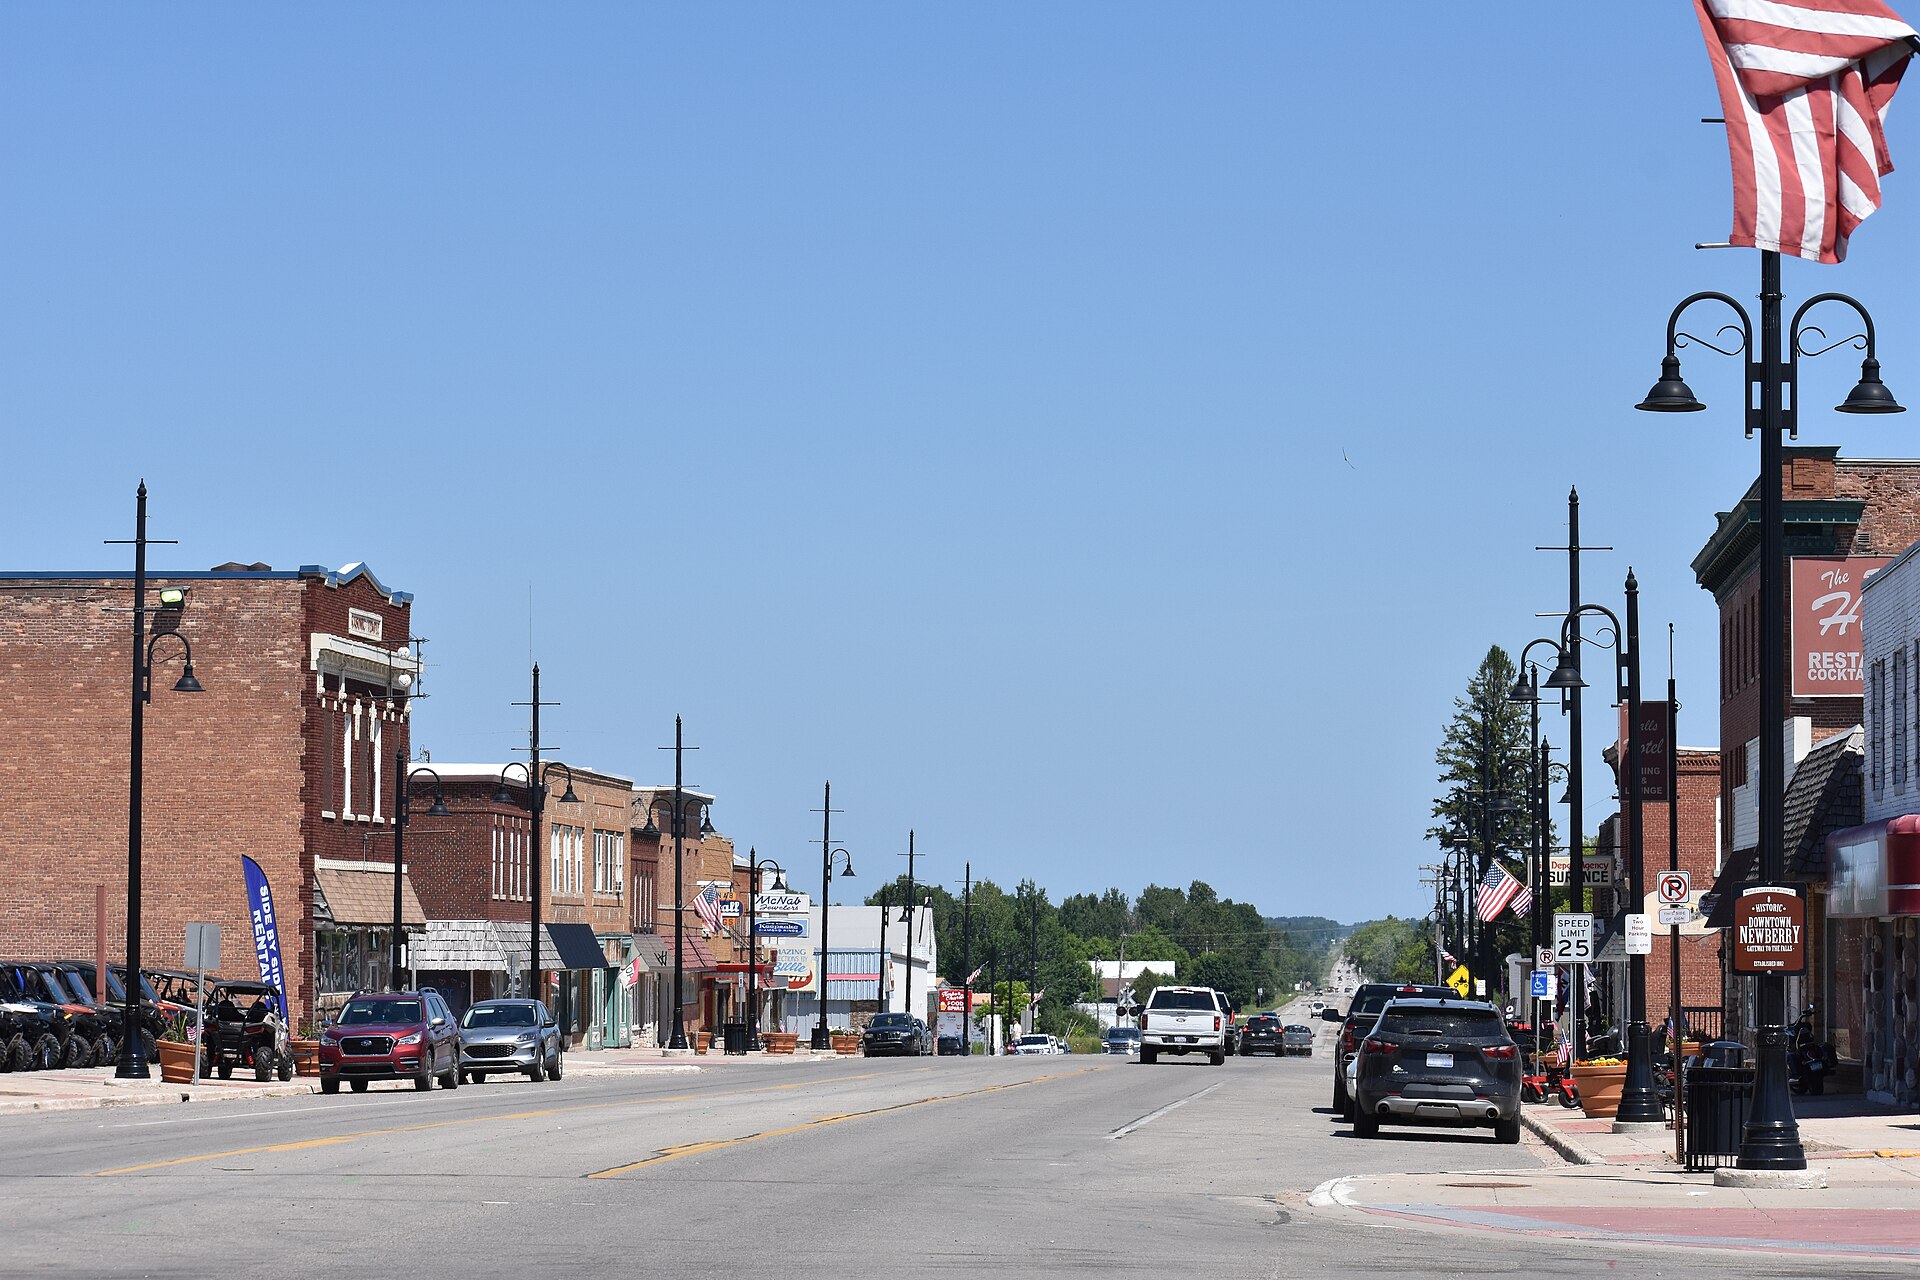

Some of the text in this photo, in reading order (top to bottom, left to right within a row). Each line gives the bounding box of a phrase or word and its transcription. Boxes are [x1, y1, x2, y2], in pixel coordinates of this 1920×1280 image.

[1821, 569, 1850, 589] The
[1812, 592, 1863, 636] H
[1625, 787, 1663, 795] LNGE
[1552, 861, 1571, 871] Depo
[1550, 871, 1609, 883] SURNCE
[756, 896, 801, 905] McNab
[1756, 904, 1783, 913] HISTORIC
[260, 885, 273, 926] SIDE
[267, 929, 277, 952] BY
[1558, 920, 1590, 928] SPEED
[1749, 917, 1791, 928] DOWNTOWN
[1740, 926, 1800, 944] NEWBERRY
[253, 910, 271, 999] RENTAL
[1558, 940, 1589, 957] 25
